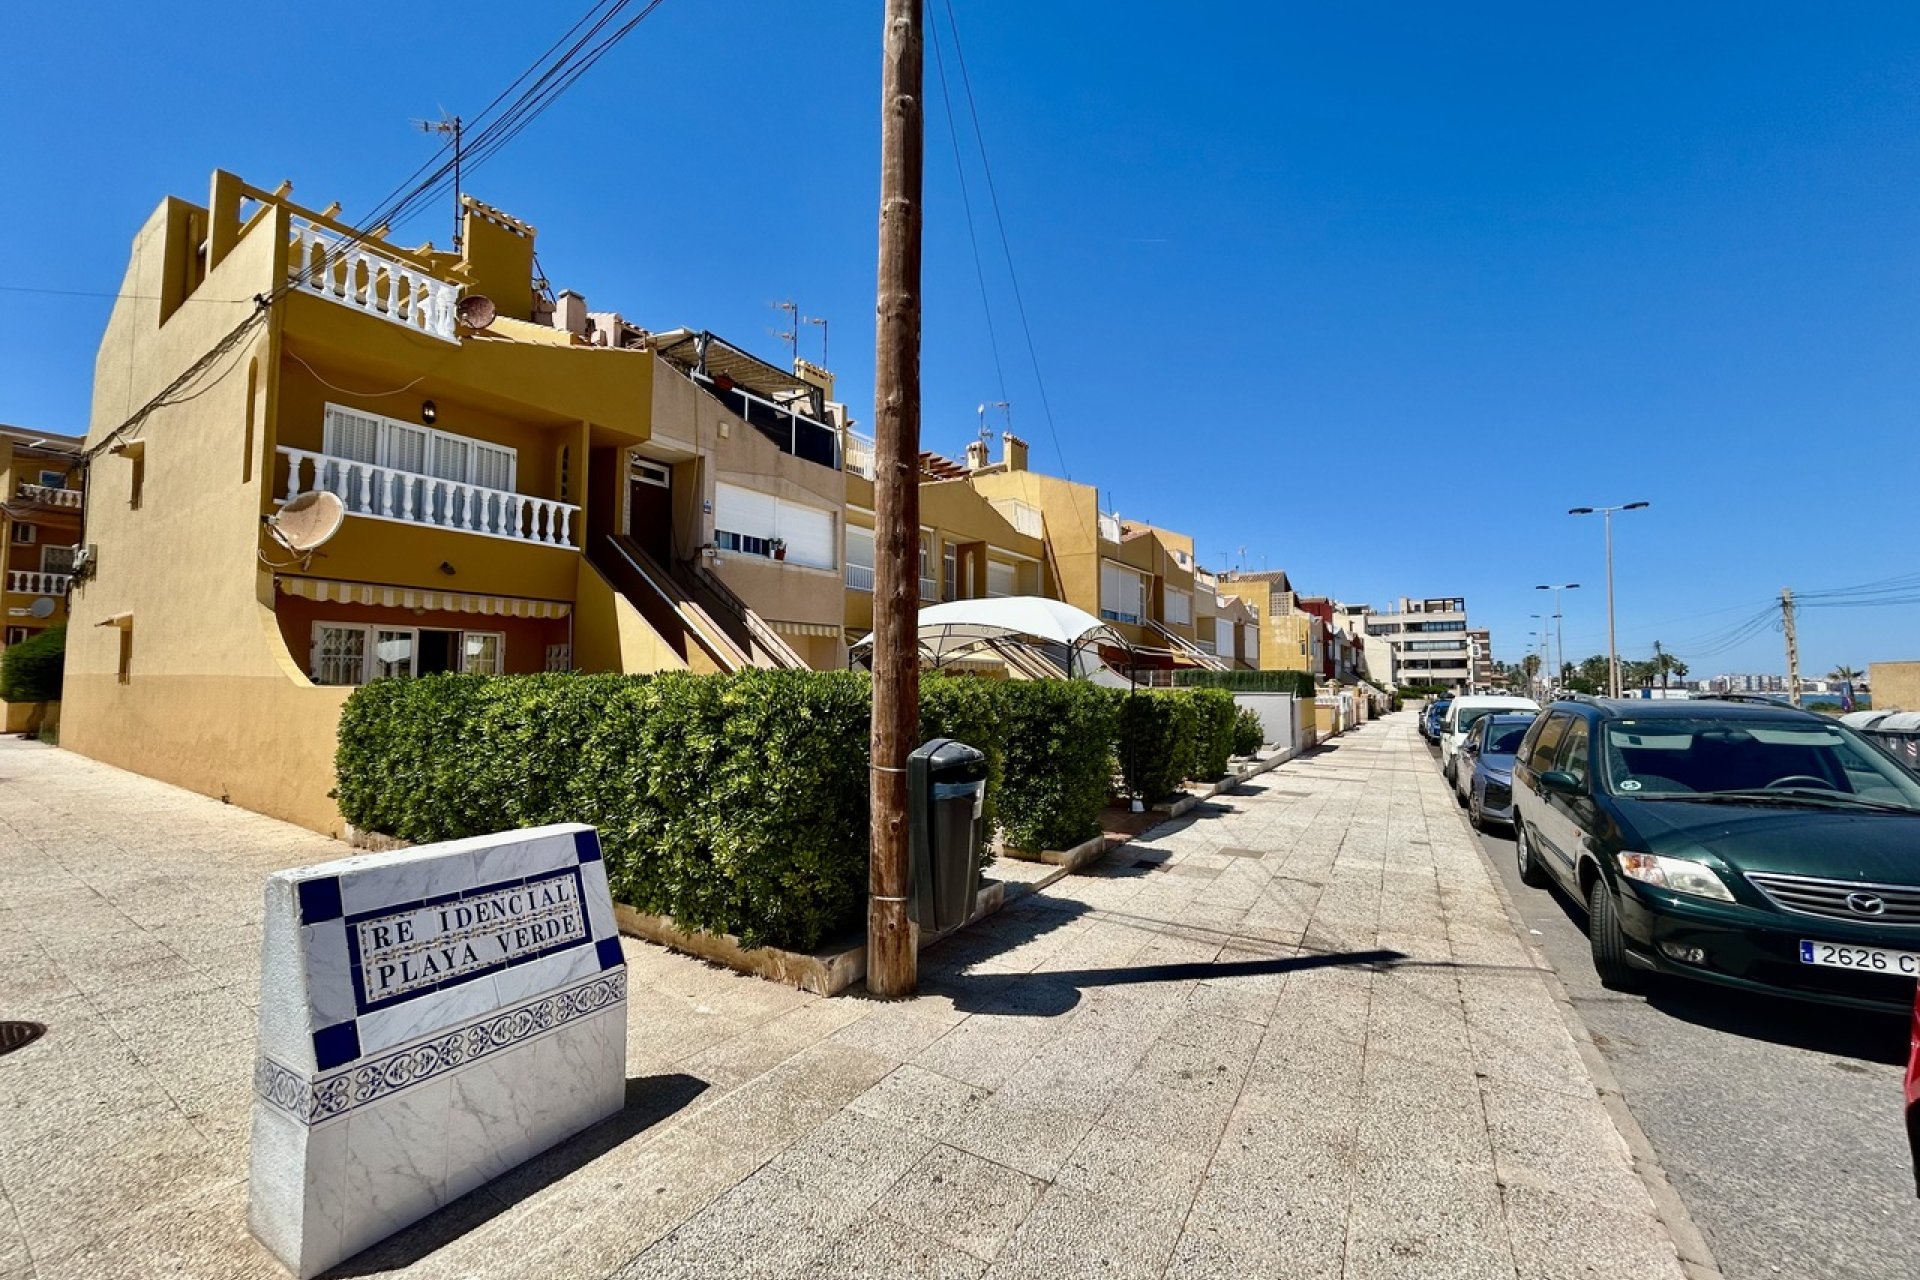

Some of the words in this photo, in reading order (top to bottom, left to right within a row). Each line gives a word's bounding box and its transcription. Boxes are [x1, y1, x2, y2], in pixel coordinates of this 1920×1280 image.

[372, 884, 570, 950] REIDENCIAL
[378, 943, 480, 990] PLAYA
[496, 914, 577, 953] VERDE
[1822, 945, 1887, 970] 2626
[1898, 954, 1920, 974] C
